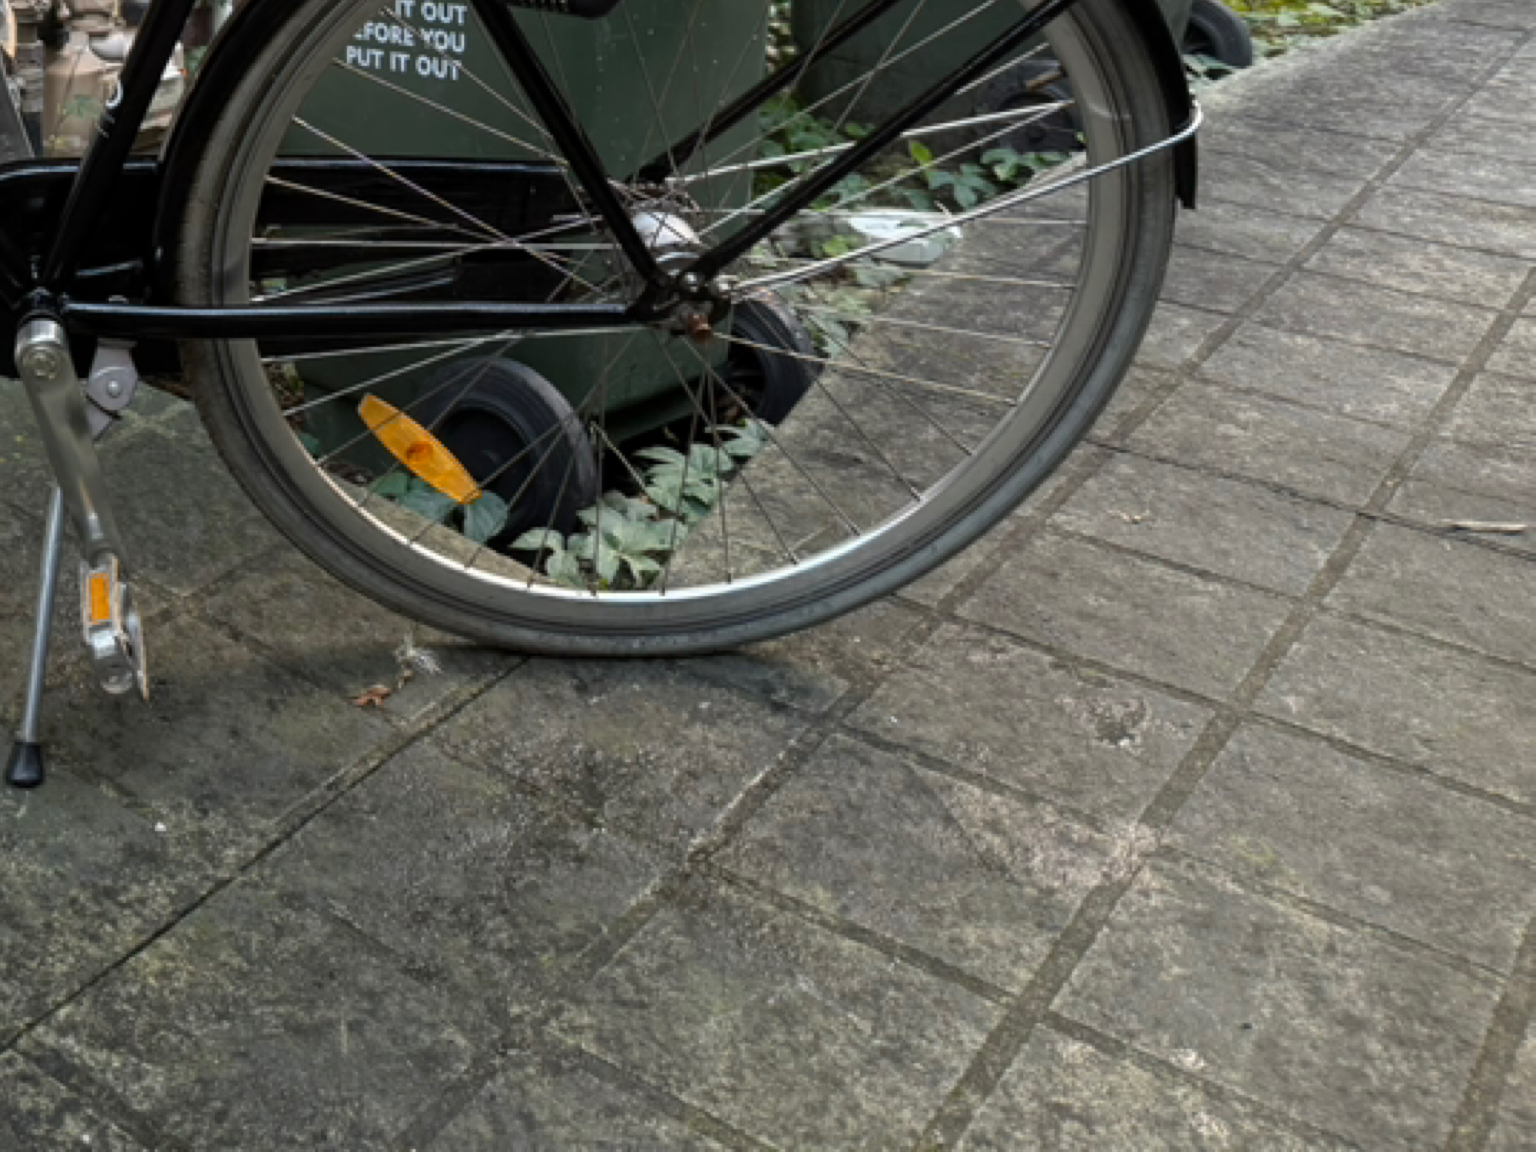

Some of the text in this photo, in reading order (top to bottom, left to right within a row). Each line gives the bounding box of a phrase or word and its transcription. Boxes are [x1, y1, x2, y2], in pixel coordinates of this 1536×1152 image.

[421, 0, 468, 26] OUT
[353, 20, 466, 53] FORE YOU
[346, 45, 461, 80] PUT IT OUT
